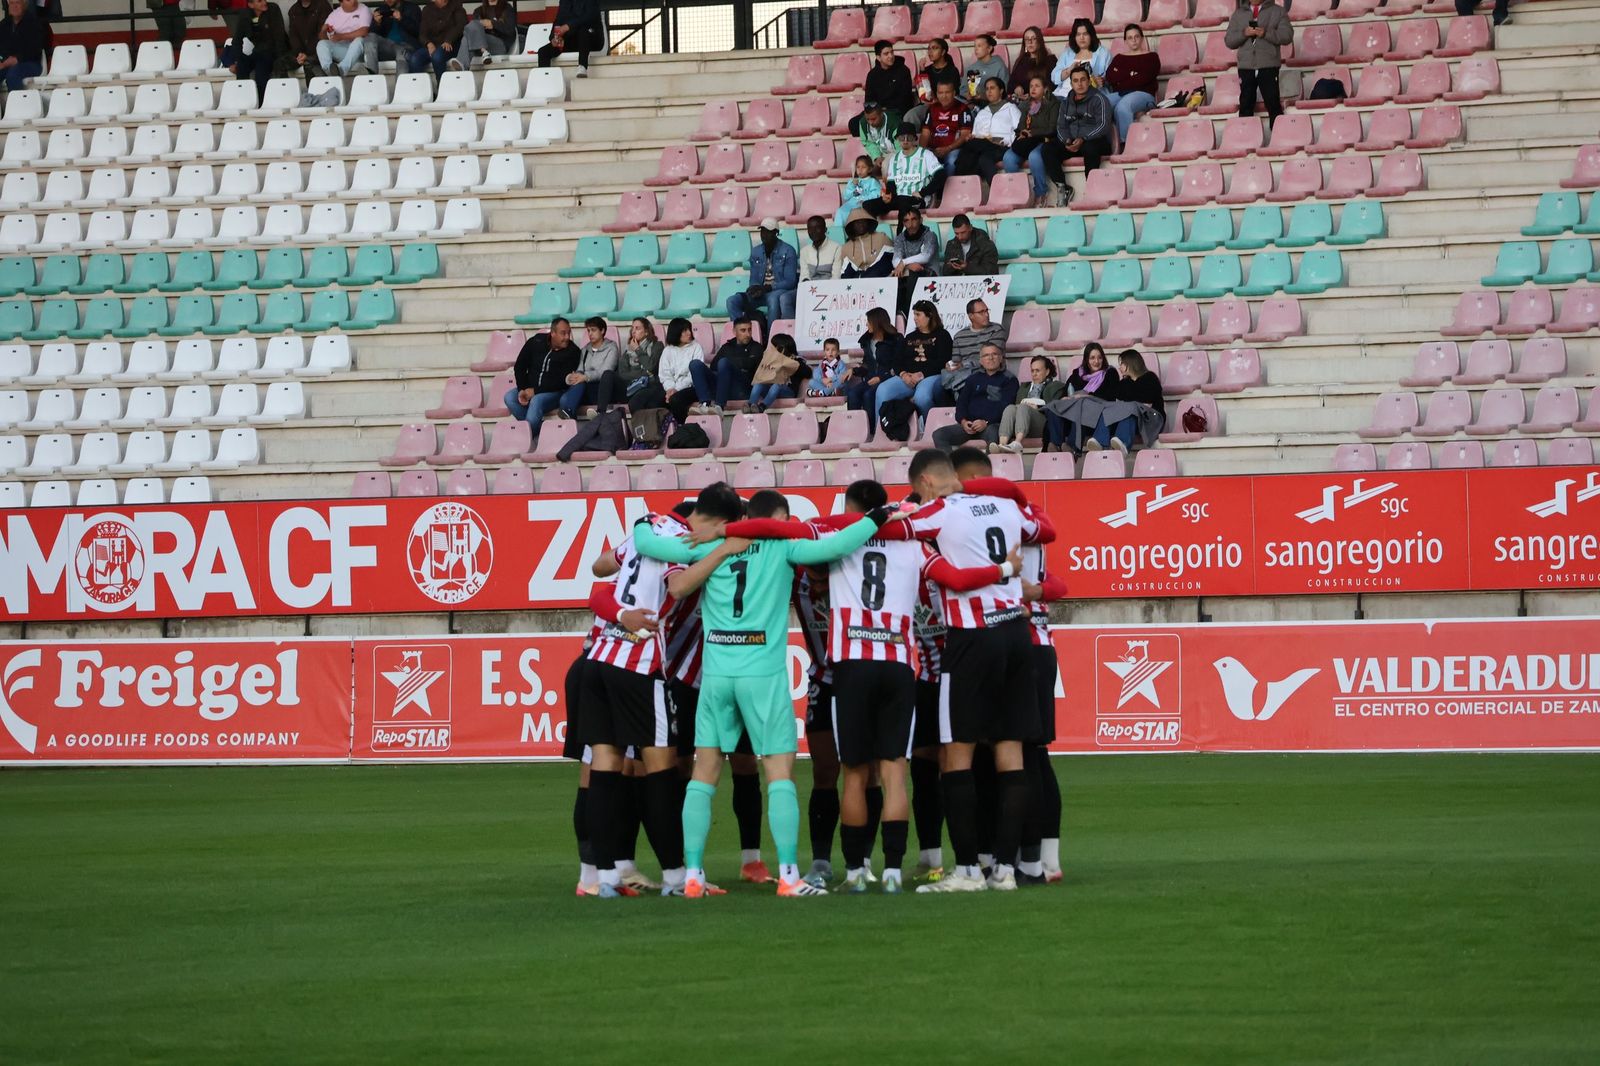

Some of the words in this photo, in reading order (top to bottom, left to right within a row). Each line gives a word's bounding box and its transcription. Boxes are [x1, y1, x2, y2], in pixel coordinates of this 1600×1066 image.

[812, 290, 877, 312] ZAMORA
[808, 314, 868, 338] CAMPEÓ
[1182, 502, 1209, 523] sgc
[1380, 497, 1409, 518] sgc
[268, 504, 388, 608] CF
[1069, 535, 1242, 579] sangregorio
[1265, 530, 1443, 574] sangregorio
[729, 560, 749, 618] 1
[861, 551, 887, 612] 8
[1111, 581, 1202, 592] CONSTRUCCION
[1308, 577, 1402, 587] CONSTRUCCION
[708, 631, 765, 644] leomotor.net
[54, 648, 301, 721] Freigel
[481, 648, 558, 708] E.S.
[1334, 703, 1355, 717] EL
[1360, 702, 1430, 716] CENTRO
[1434, 701, 1537, 716] COMERCIAL
[1541, 700, 1564, 714] DE
[47, 733, 58, 748] A
[65, 733, 147, 748] GOODLIFE
[154, 733, 209, 747] FOODS
[216, 732, 300, 746] COMPANY
[374, 728, 449, 748] RepoSTAR
[1097, 720, 1180, 742] RepoSTAR
